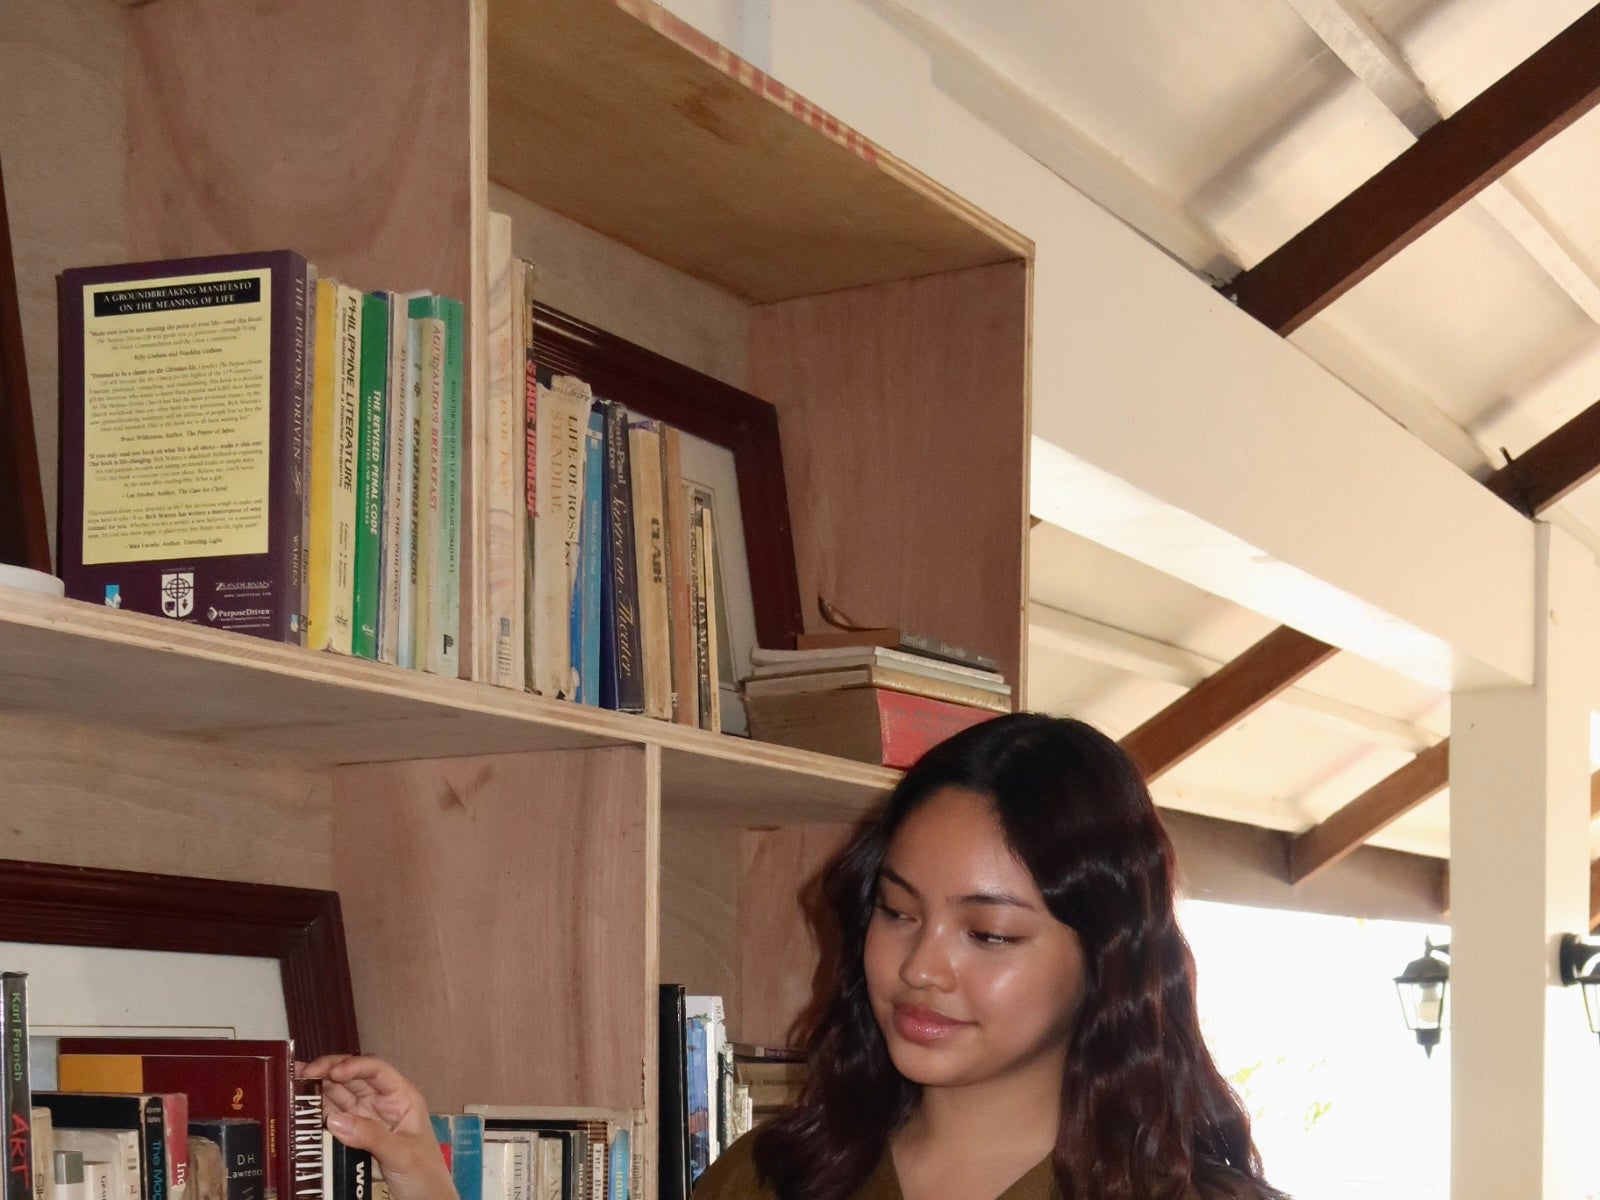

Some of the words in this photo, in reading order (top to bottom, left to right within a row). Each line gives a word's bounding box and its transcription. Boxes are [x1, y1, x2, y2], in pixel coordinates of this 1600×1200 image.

[104, 294, 110, 302] A
[112, 287, 197, 302] GROUNDBREAKING
[199, 281, 252, 294] MANIFESTO
[119, 303, 134, 312] ON
[136, 301, 154, 311] THE
[156, 297, 199, 310] MEANING
[201, 296, 214, 305] OF
[215, 294, 236, 303] LIFE
[295, 278, 305, 311] THE
[294, 316, 304, 391] PURPOSE
[346, 297, 358, 389] PHILIPPINE
[431, 326, 442, 425] AGUINALDO'S
[526, 359, 537, 423] STAGE
[373, 390, 382, 413] THE
[293, 395, 303, 459] DRIVEN
[343, 393, 355, 493] LITERATURE
[372, 416, 381, 460] REVISED
[567, 415, 578, 460] LIFE
[607, 418, 616, 469] Sartre
[615, 406, 627, 484] Jean-Paul
[371, 464, 380, 500] PENAL
[429, 429, 440, 512] BREAKFAST
[551, 410, 563, 513] STENDHAL
[567, 464, 578, 488] OF
[369, 504, 379, 534] CODE
[292, 535, 300, 586] WARREN
[616, 557, 626, 584] on
[218, 609, 270, 617] PurposeDriven
[618, 591, 635, 677] Theater
[697, 601, 708, 685] DAMAGE
[11, 991, 23, 1023] Karl
[12, 1028, 24, 1081] French
[10, 1113, 29, 1190] ART
[152, 1140, 163, 1166] The
[294, 1094, 323, 1182] PATRICIA
[593, 1147, 602, 1173] THE
[226, 1168, 264, 1179] Lawrence
[513, 1151, 523, 1181] THE
